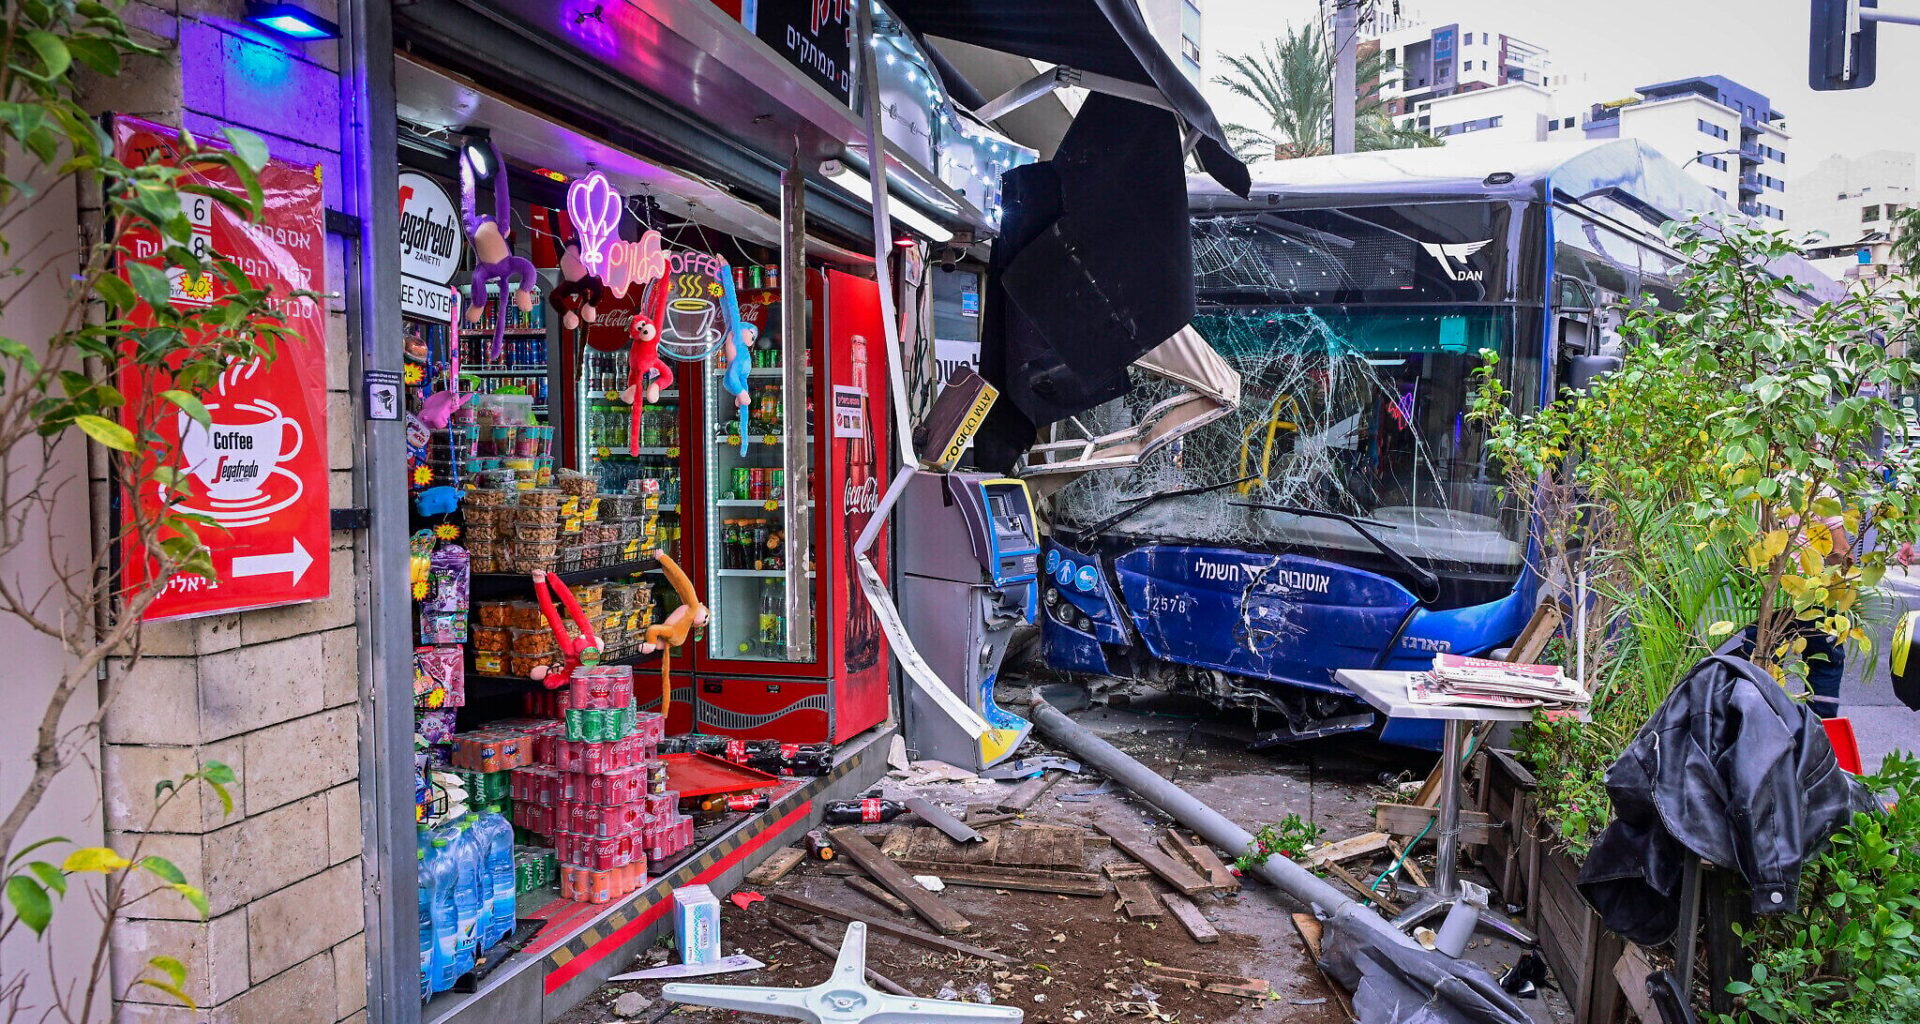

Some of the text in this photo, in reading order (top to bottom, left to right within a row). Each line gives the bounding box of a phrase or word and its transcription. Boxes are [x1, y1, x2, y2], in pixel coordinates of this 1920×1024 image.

[786, 24, 835, 82] ממתקים
[194, 198, 205, 221] 6
[194, 236, 205, 259] 8
[415, 251, 441, 267] ZANETTI
[1457, 270, 1483, 282] DAN
[973, 392, 991, 417] ATM
[214, 431, 253, 450] Coffee
[211, 455, 259, 484] Segafredo
[1195, 557, 1240, 583] חשמלי
[1145, 596, 1186, 614] 12578
[1401, 636, 1451, 652] הארגז
